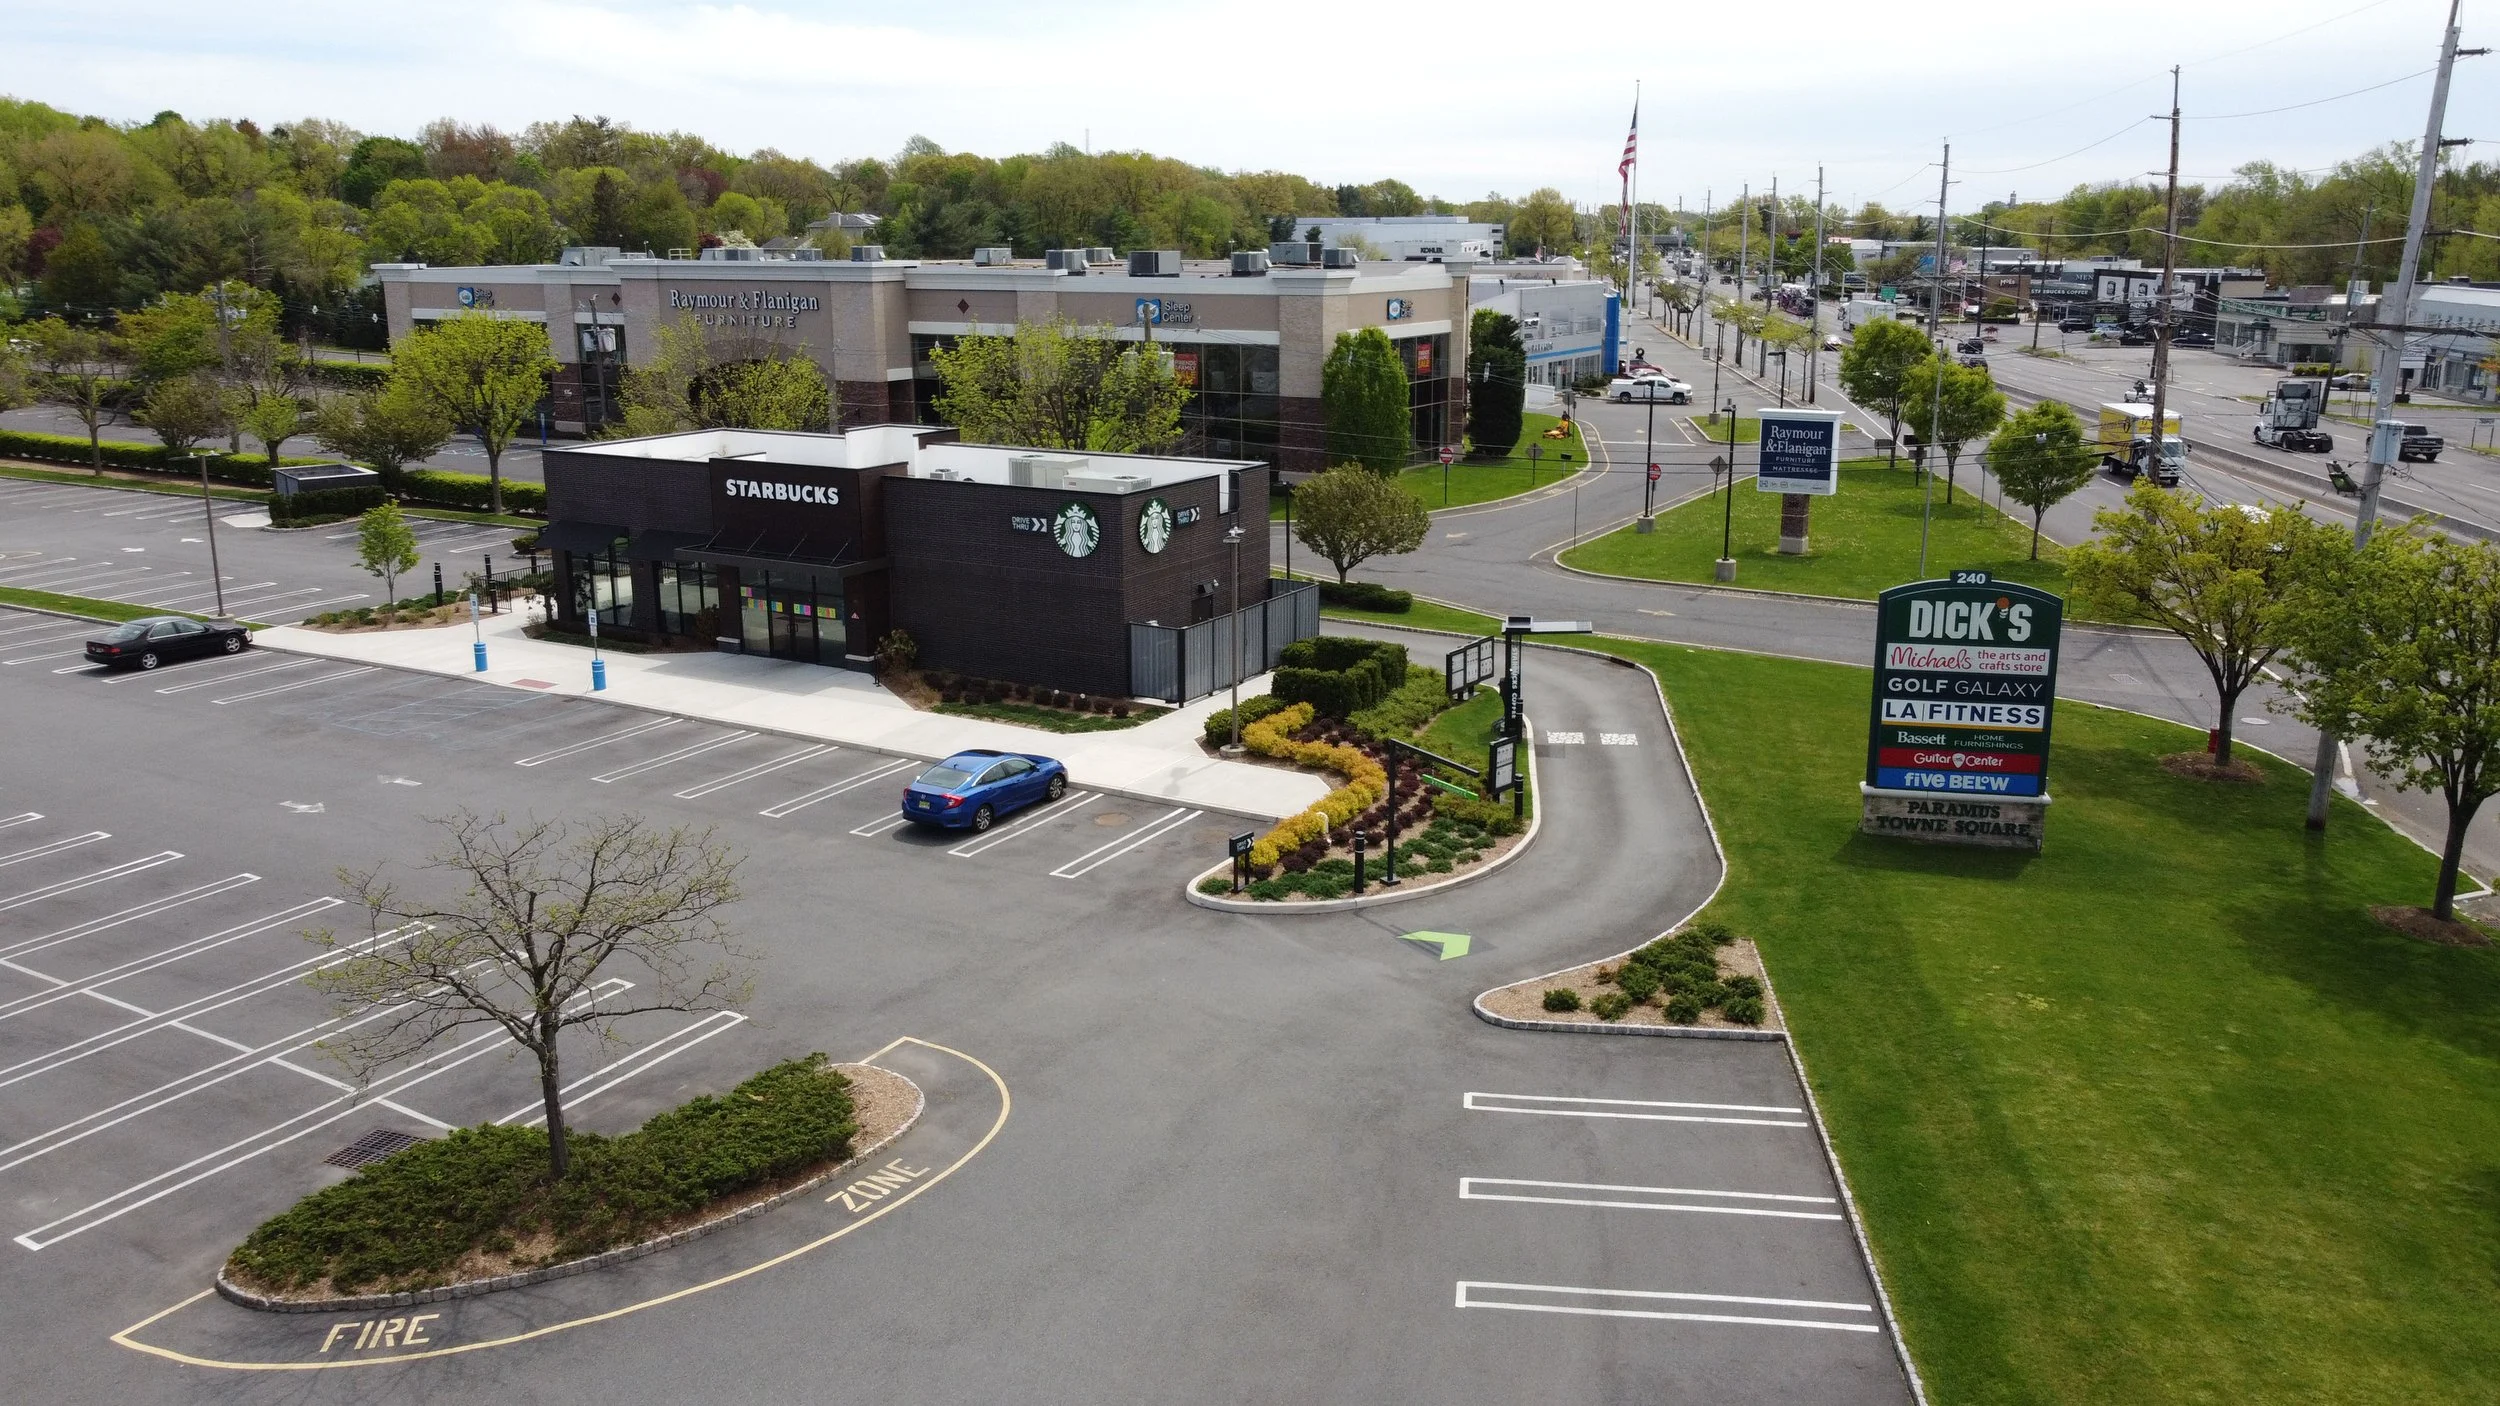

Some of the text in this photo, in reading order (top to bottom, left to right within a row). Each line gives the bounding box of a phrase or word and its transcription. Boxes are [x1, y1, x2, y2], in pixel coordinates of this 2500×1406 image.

[670, 289, 819, 314] Raymour & Flanigan
[1164, 301, 1191, 314] Sleep
[694, 313, 797, 329] FURNITURE
[1162, 312, 1194, 323] Center
[1770, 425, 1824, 440] Raymour
[1775, 456, 1816, 464] FURNITURE
[725, 479, 839, 506] STARBUCKS
[1011, 516, 1031, 525] DRIVE
[1012, 523, 1030, 531] THRU
[1956, 572, 1987, 585] 240
[1908, 597, 2034, 642] DICK'S
[1890, 646, 1973, 670] Michaels
[1977, 649, 2047, 662] the arts and
[1978, 660, 2043, 673] crafts store
[1887, 677, 2043, 698] GOLF GALAXY
[1885, 701, 2042, 725] LA FITNESS
[1896, 731, 1947, 746] Bassett
[1954, 739, 2024, 750] FURNISHINGS
[1973, 734, 2005, 742] HOME
[1913, 752, 2004, 768] Guitar Center
[1907, 801, 2001, 819] PARAMUS
[1876, 815, 2032, 837] TOWNE SQUARE
[824, 1157, 932, 1213] ZONE
[319, 1313, 441, 1353] FIRE
